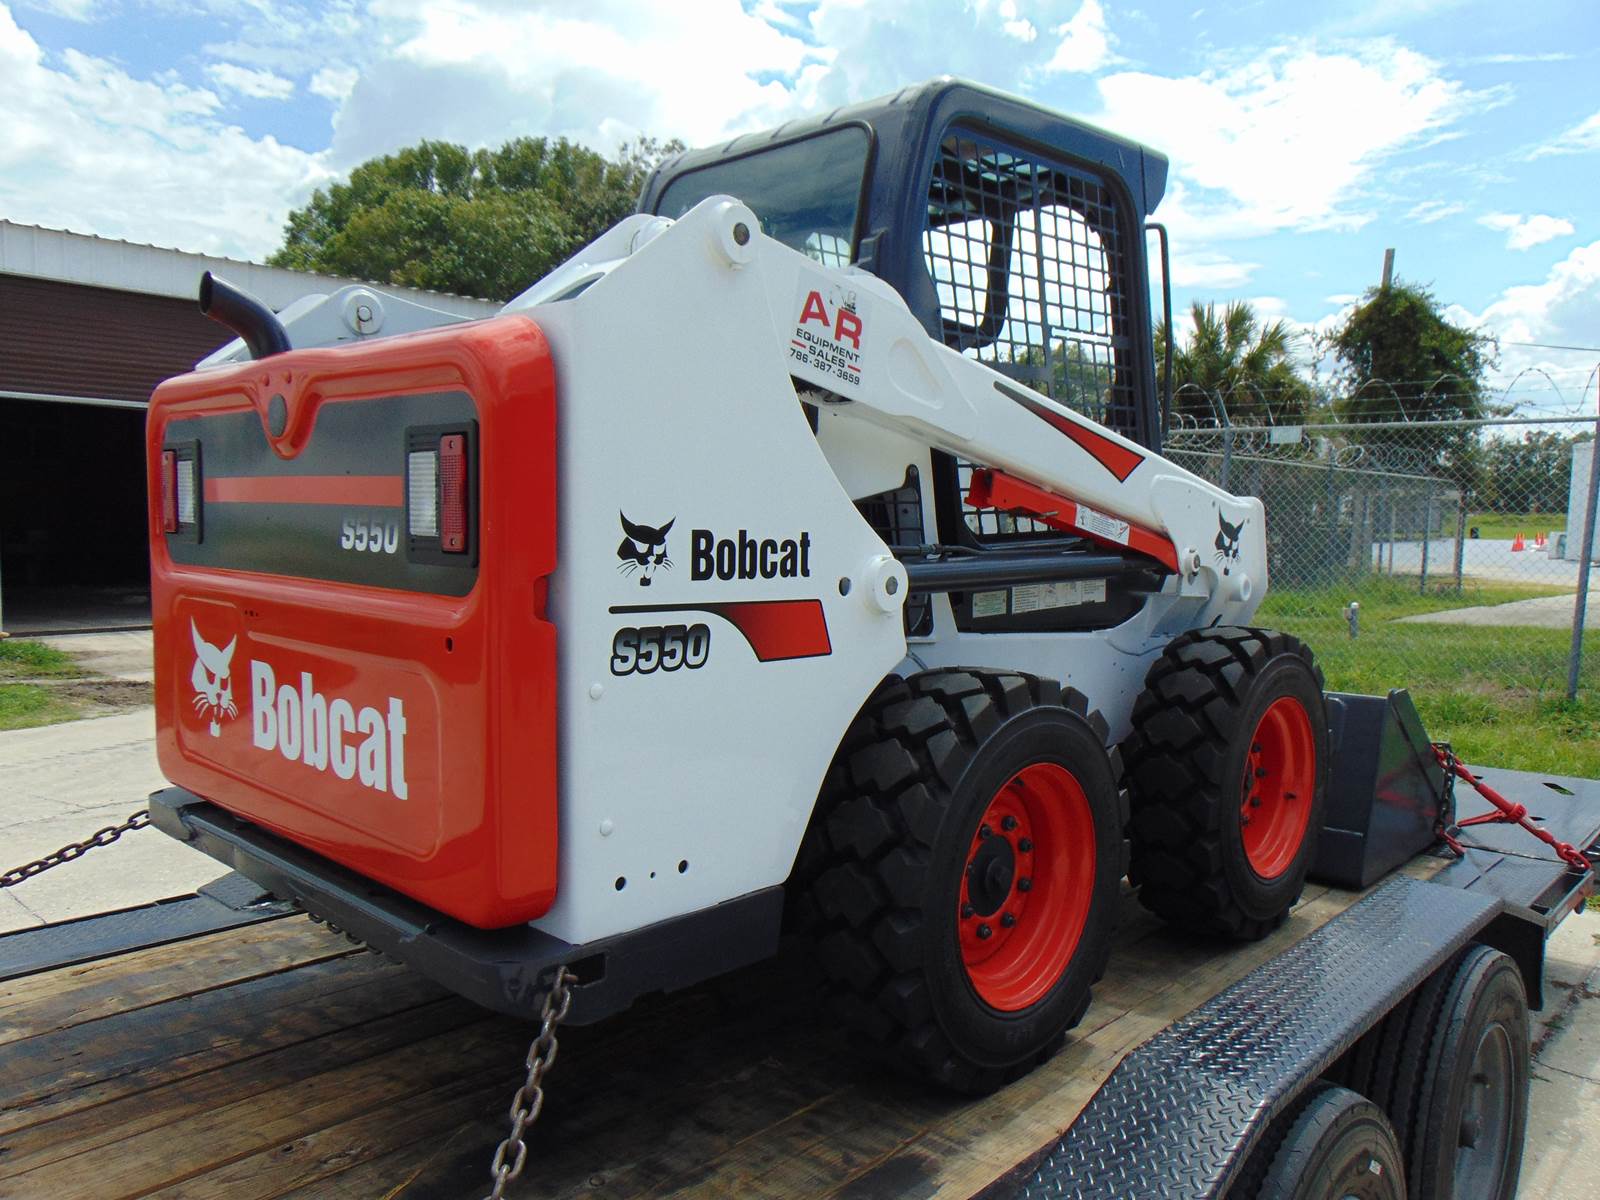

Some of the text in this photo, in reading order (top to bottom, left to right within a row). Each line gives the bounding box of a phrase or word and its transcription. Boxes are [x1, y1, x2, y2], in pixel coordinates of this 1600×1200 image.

[796, 328, 860, 363] EQUIPMENT
[808, 345, 845, 368] SALES
[341, 519, 399, 554] S550
[691, 529, 811, 581] Bobcat
[610, 623, 711, 676] S550
[250, 659, 409, 800] Bobcat
